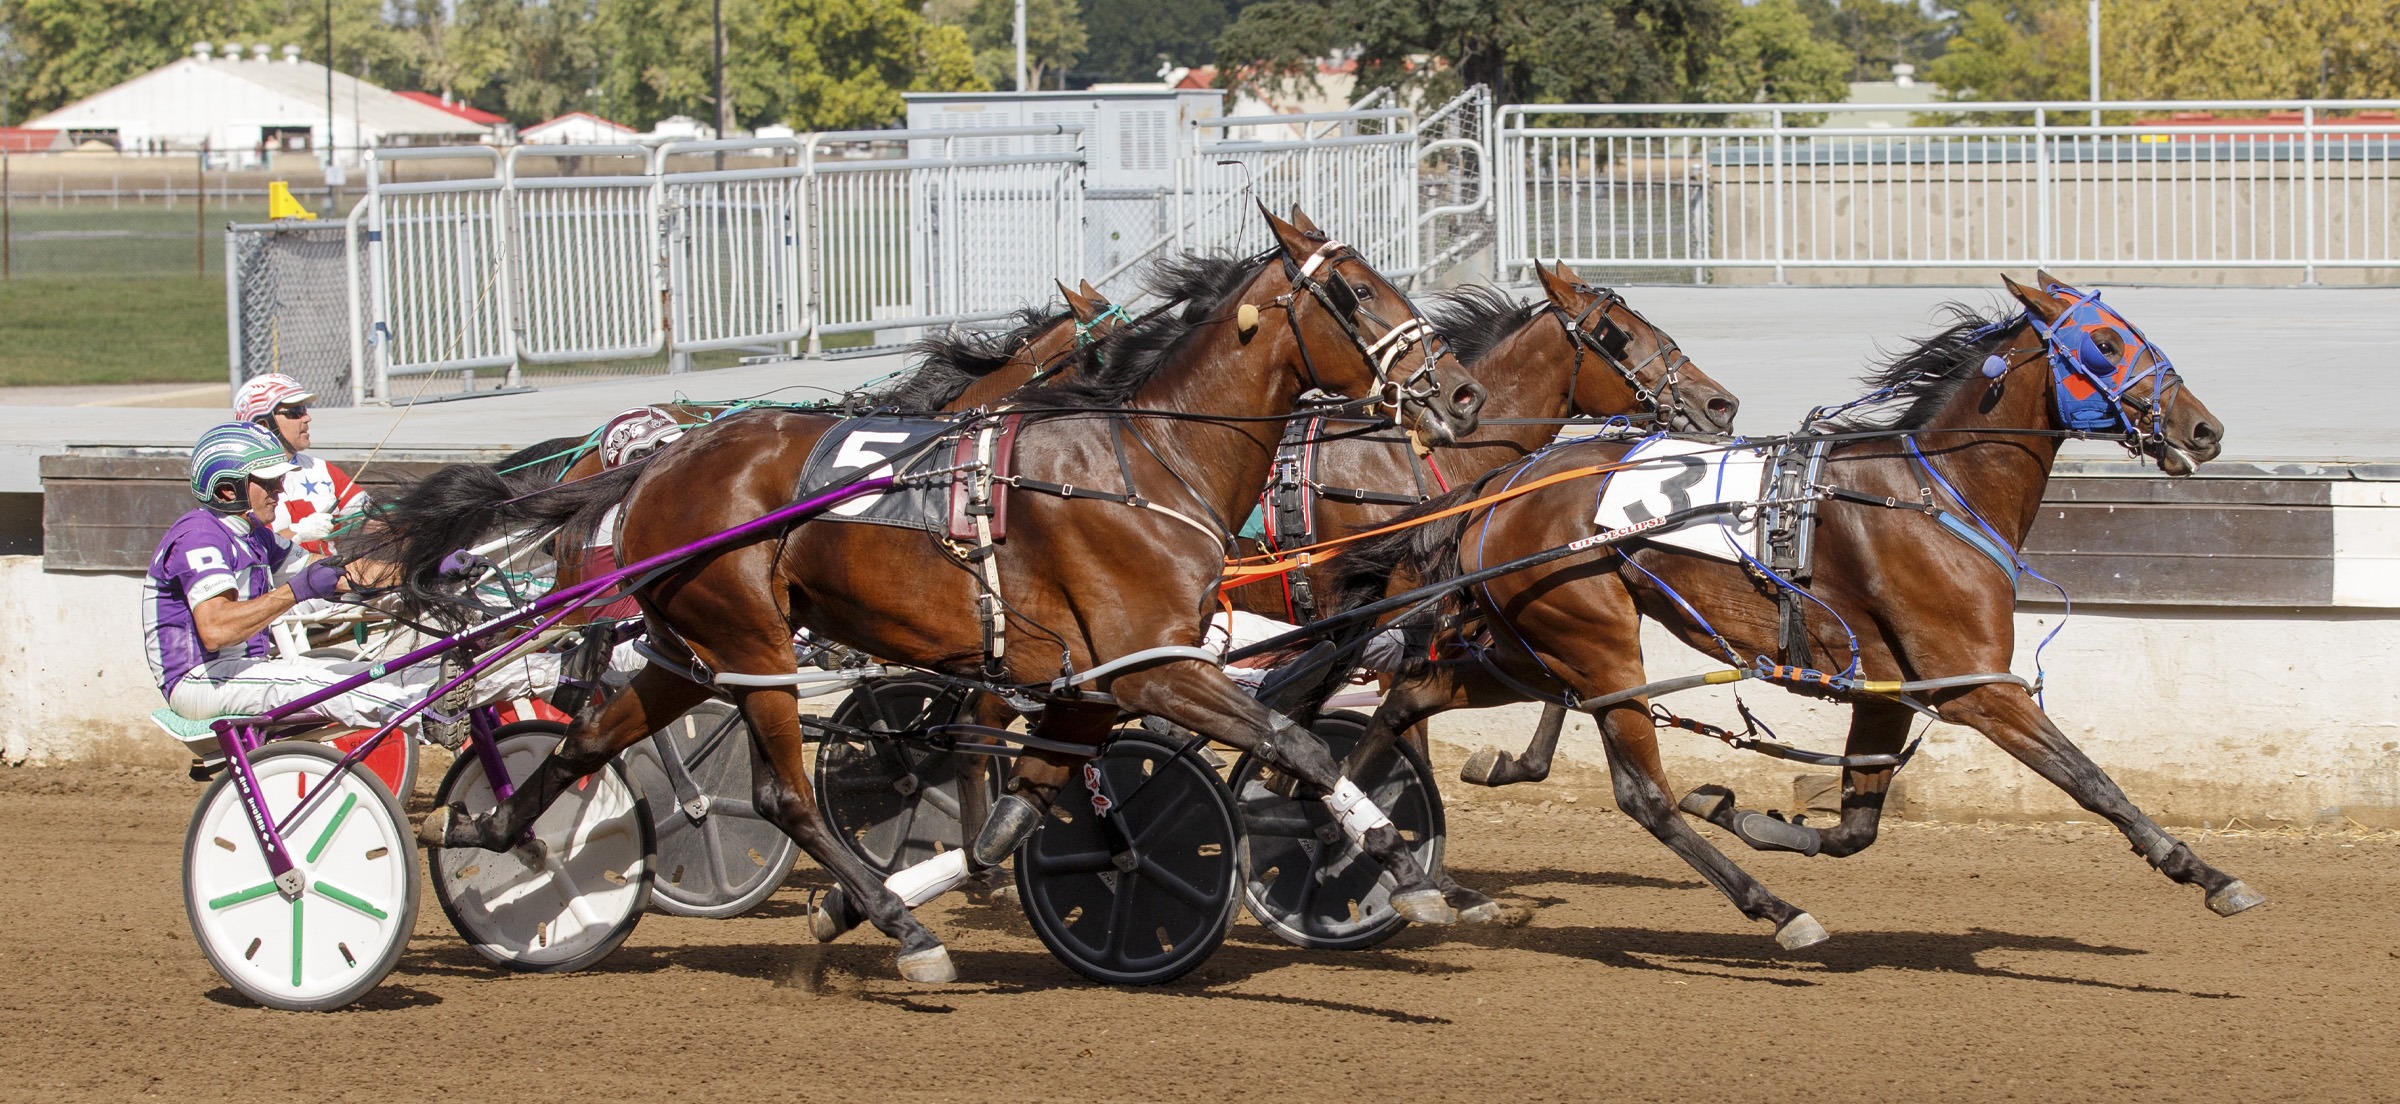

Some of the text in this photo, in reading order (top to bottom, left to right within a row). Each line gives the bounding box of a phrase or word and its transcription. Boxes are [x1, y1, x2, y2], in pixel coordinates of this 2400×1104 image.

[825, 431, 911, 516] 5
[1622, 455, 1707, 524] 3
[185, 546, 230, 574] B
[468, 617, 500, 635] Brandon
